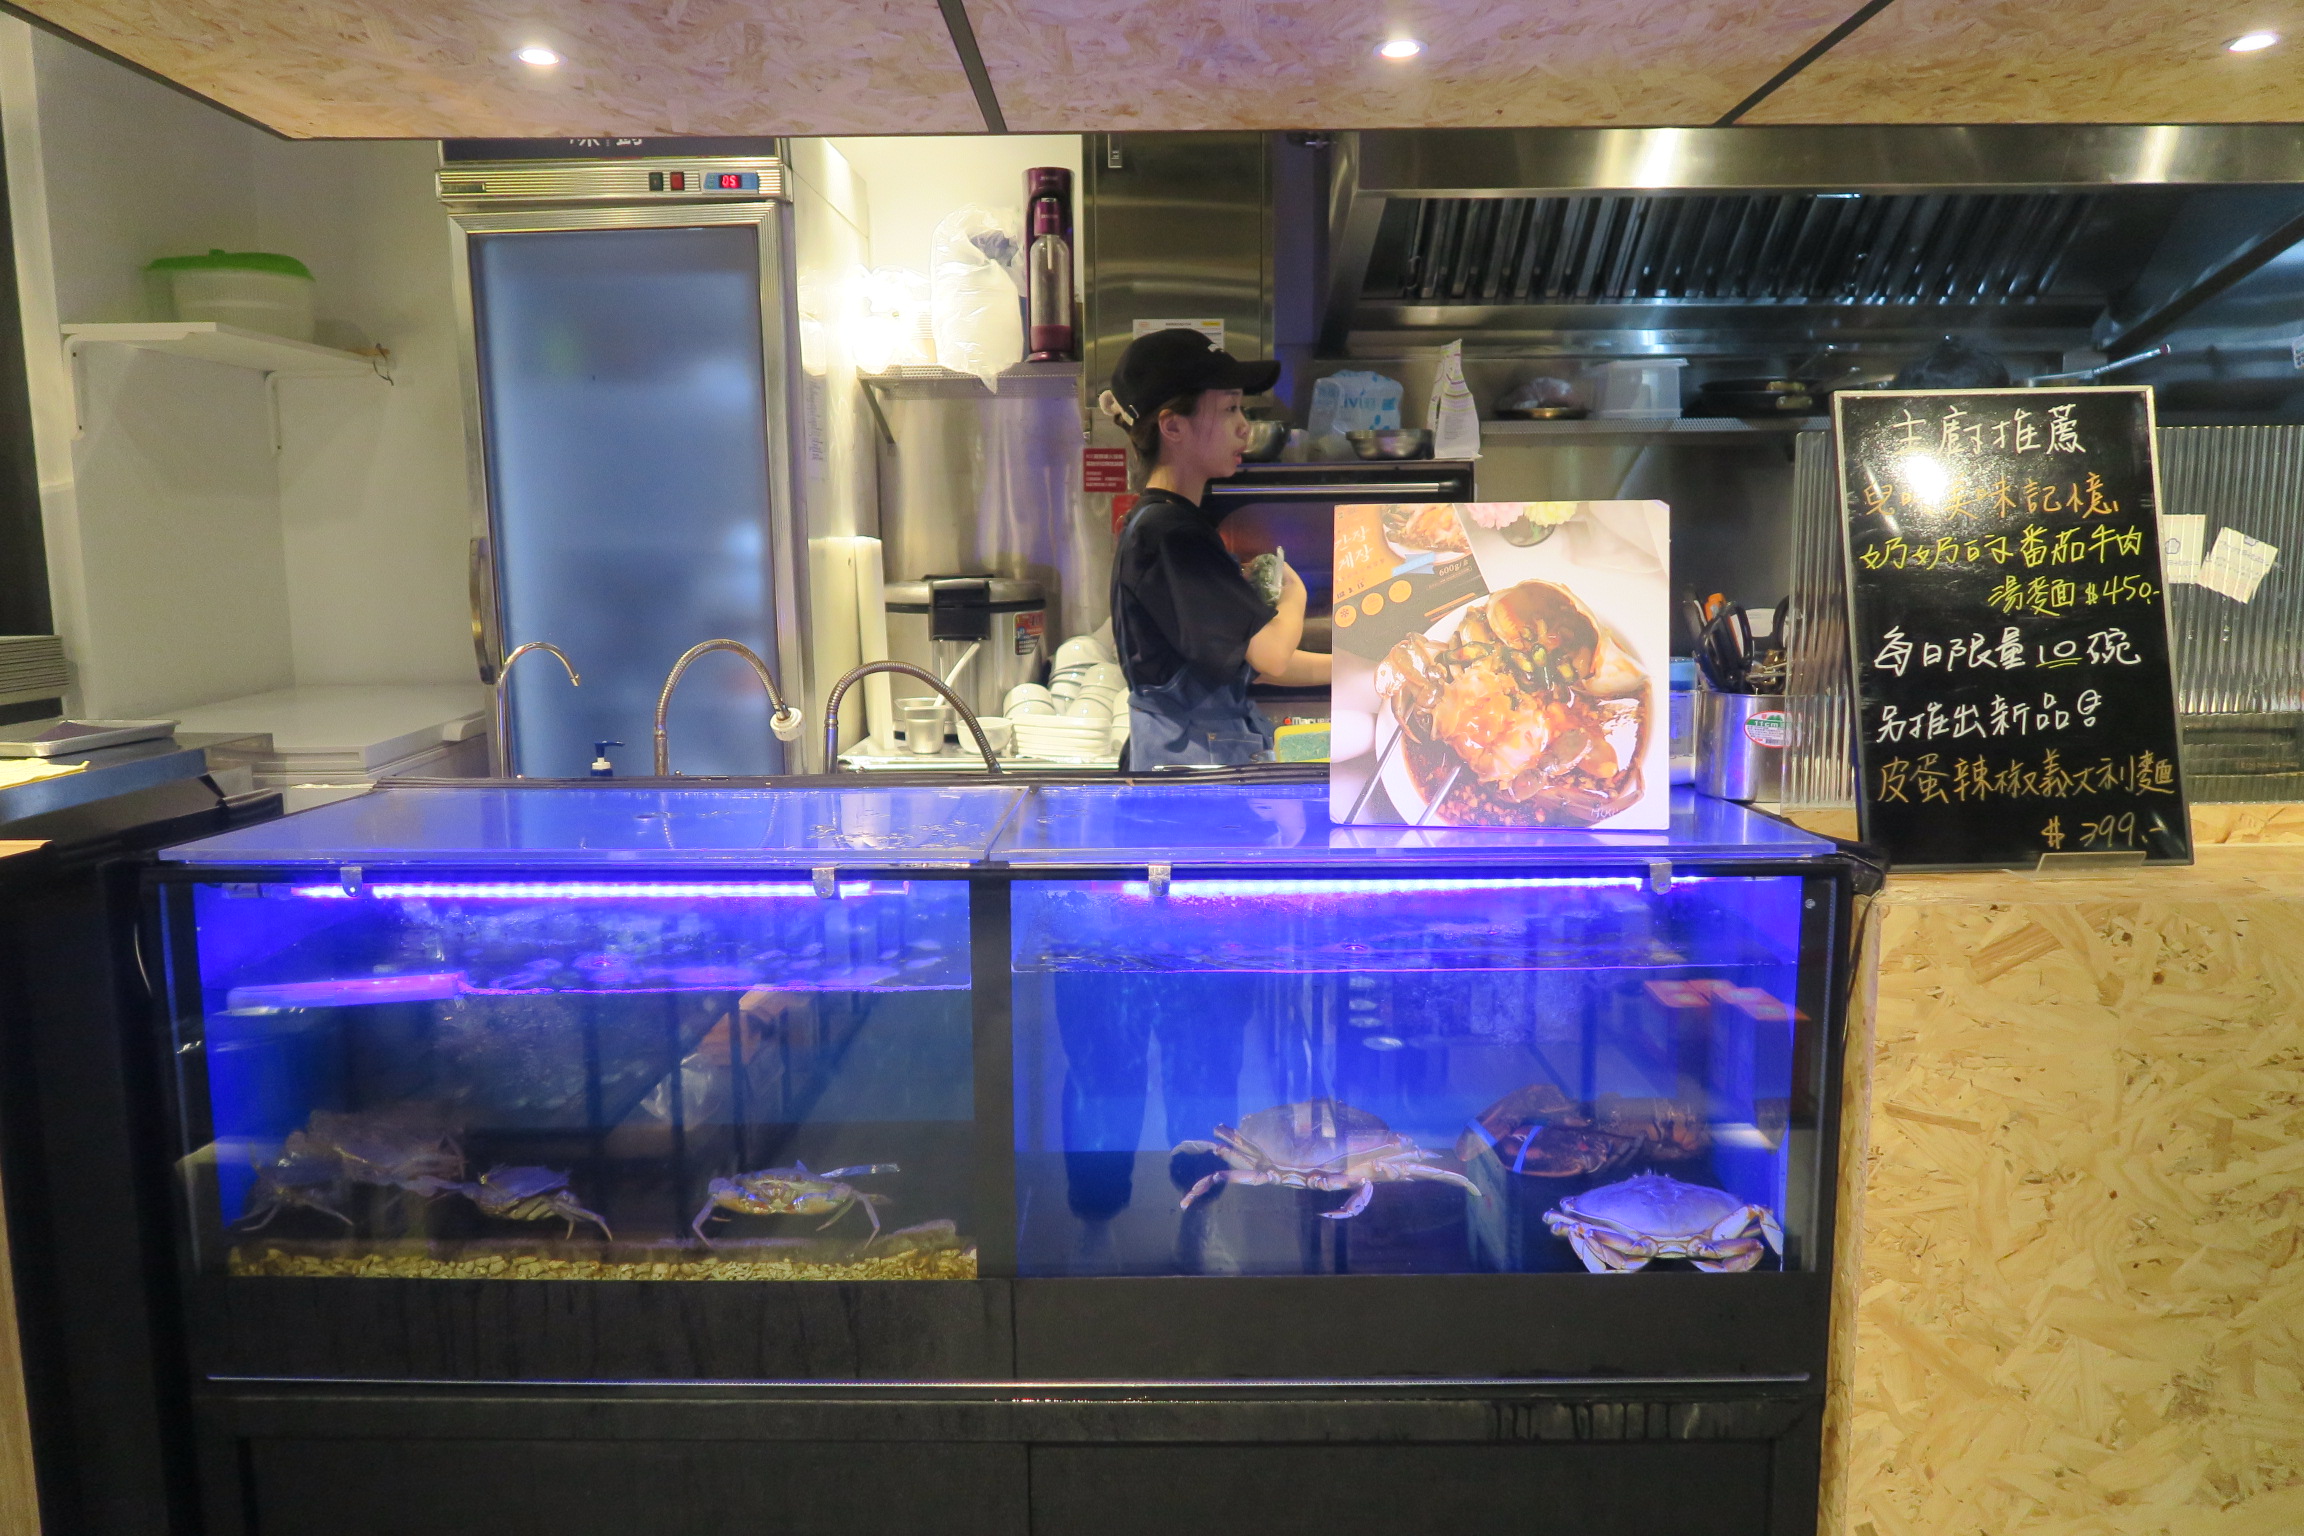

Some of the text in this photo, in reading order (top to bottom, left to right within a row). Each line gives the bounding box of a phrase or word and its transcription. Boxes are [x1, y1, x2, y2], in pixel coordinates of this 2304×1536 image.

[1892, 404, 2086, 454] 主廚推薦
[1860, 523, 2142, 570] 奶奶的番茄牛肉
[1753, 720, 1779, 728] 11cm
[1878, 748, 2175, 803] 皮蛋辣椒義大利麵
